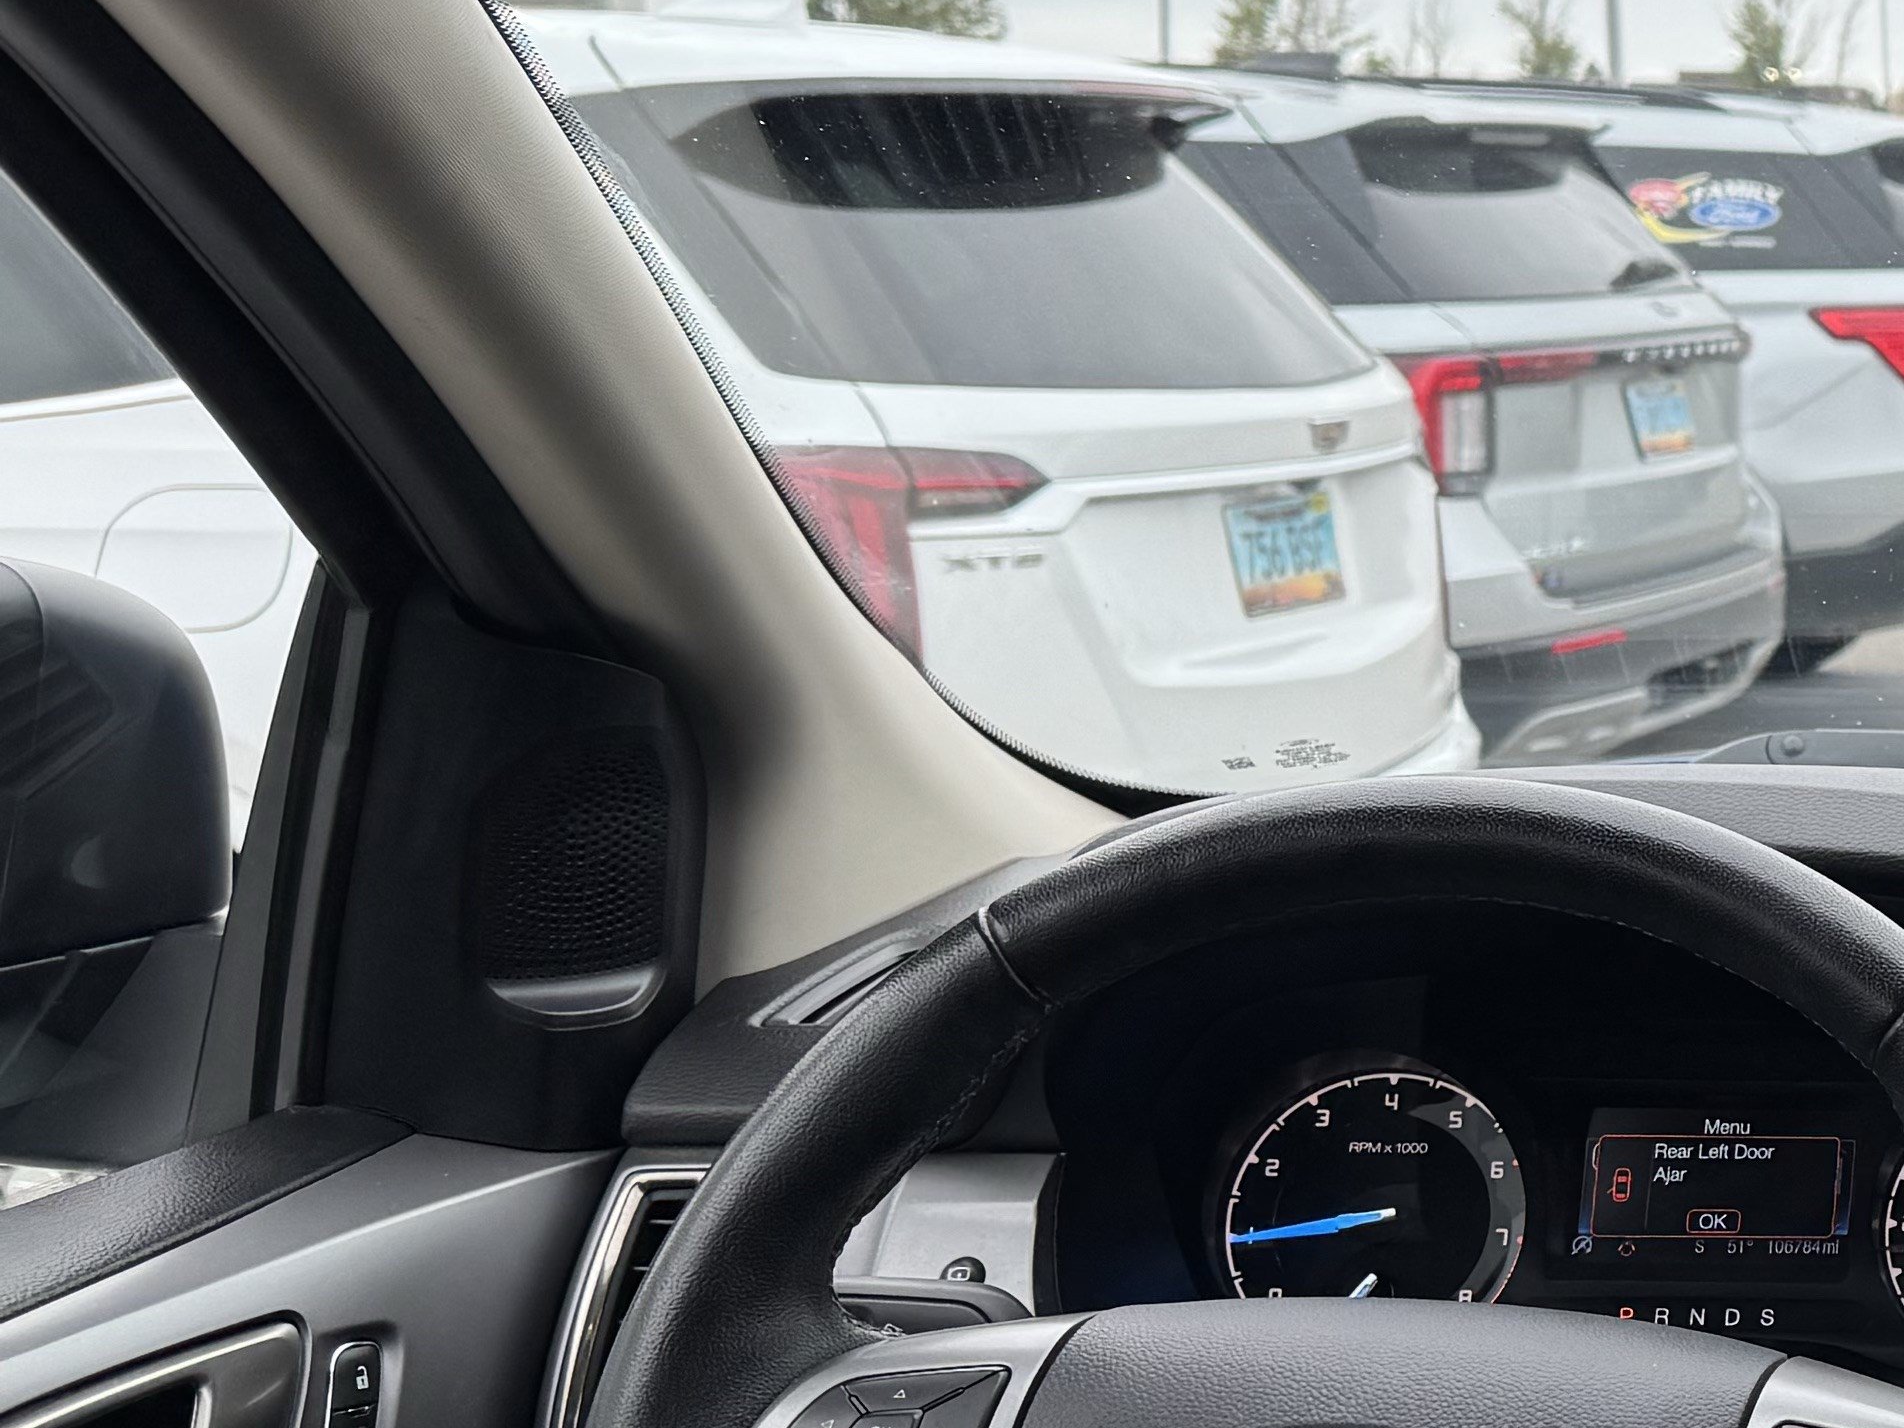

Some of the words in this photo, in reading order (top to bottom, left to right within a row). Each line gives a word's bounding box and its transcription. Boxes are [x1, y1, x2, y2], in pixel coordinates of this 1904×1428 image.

[1384, 1093, 1400, 1111] 4
[1315, 1109, 1330, 1127] 3
[1448, 1111, 1463, 1129] 5
[1703, 1118, 1751, 1135] Menu
[1348, 1141, 1386, 1154] RPM
[1384, 1145, 1395, 1154] x
[1396, 1142, 1429, 1154] 1000
[1653, 1143, 1694, 1159] Rear
[1698, 1143, 1730, 1160] Left
[1734, 1144, 1775, 1160] Door
[1265, 1158, 1280, 1177] 2
[1490, 1161, 1504, 1179] 6
[1652, 1166, 1688, 1186] Ajar
[1698, 1213, 1728, 1229] OK
[1495, 1228, 1510, 1247] 7
[1654, 1307, 1670, 1326] R
[1689, 1307, 1706, 1326] N
[1724, 1308, 1741, 1326] D
[1760, 1308, 1775, 1326] S
